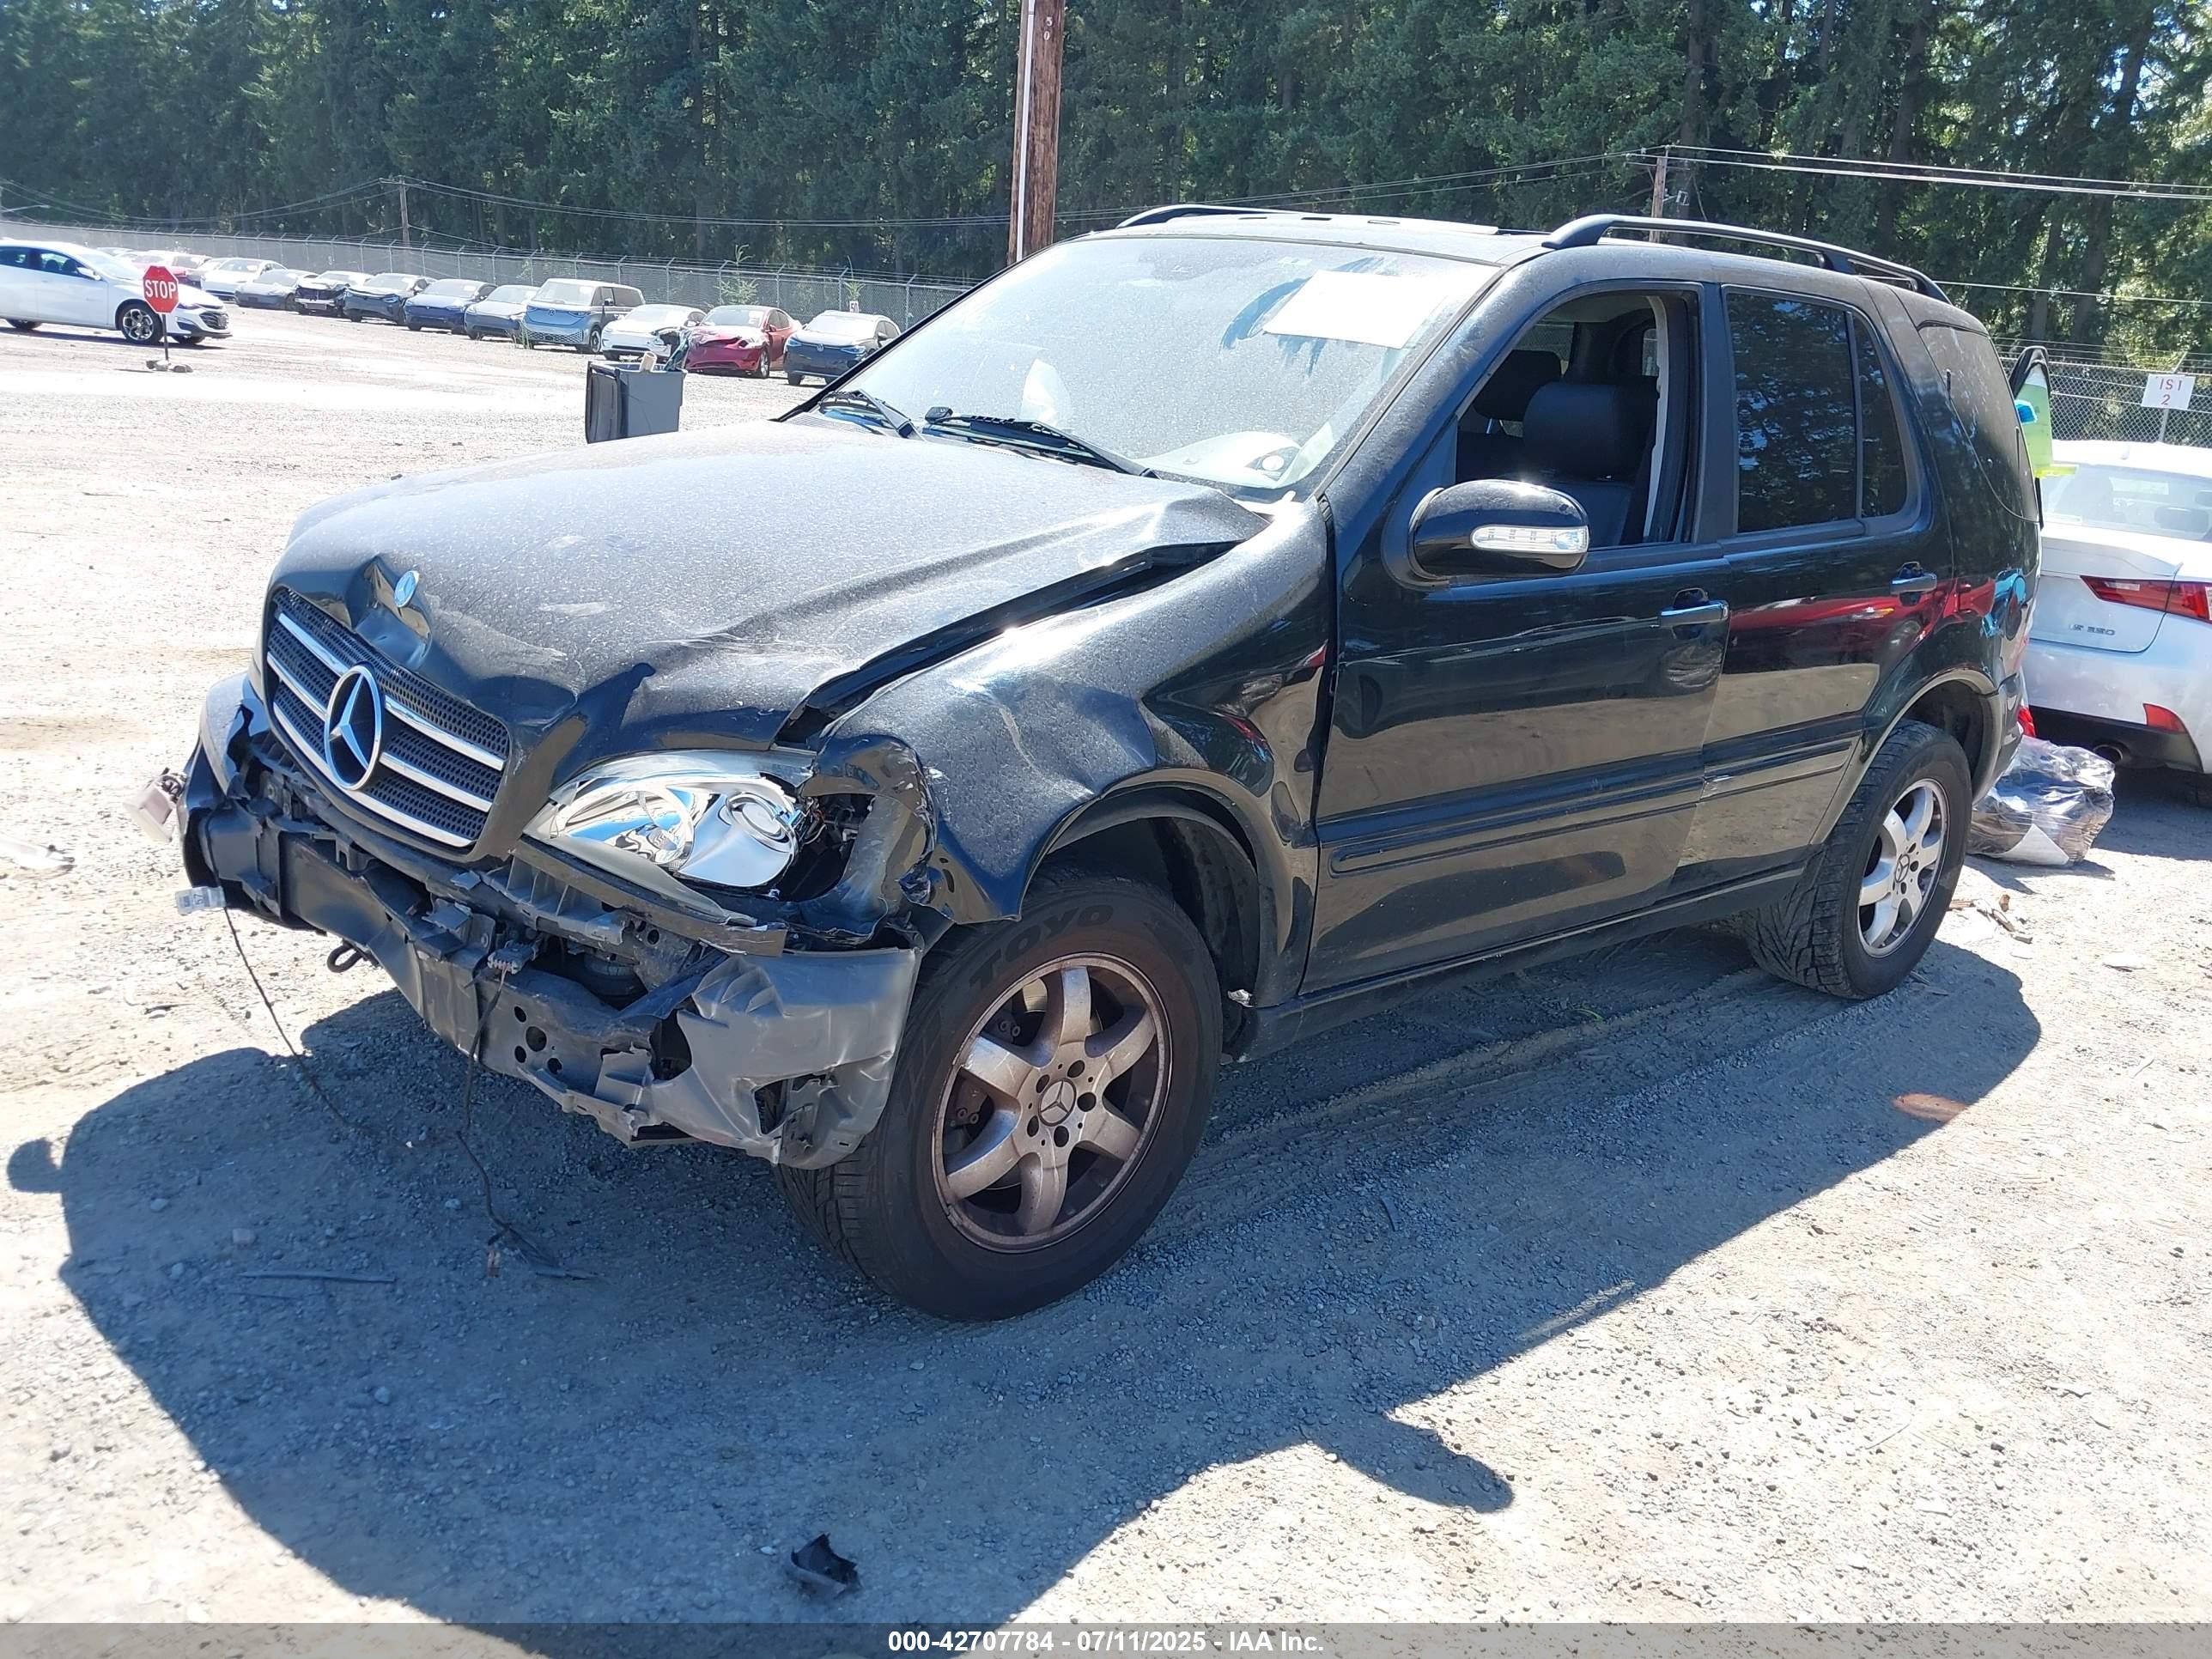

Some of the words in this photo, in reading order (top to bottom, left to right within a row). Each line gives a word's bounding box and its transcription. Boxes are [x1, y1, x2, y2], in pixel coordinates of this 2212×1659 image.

[144, 279, 177, 300] STOP
[2160, 393, 2171, 405] 2
[969, 904, 1115, 988] TOYO
